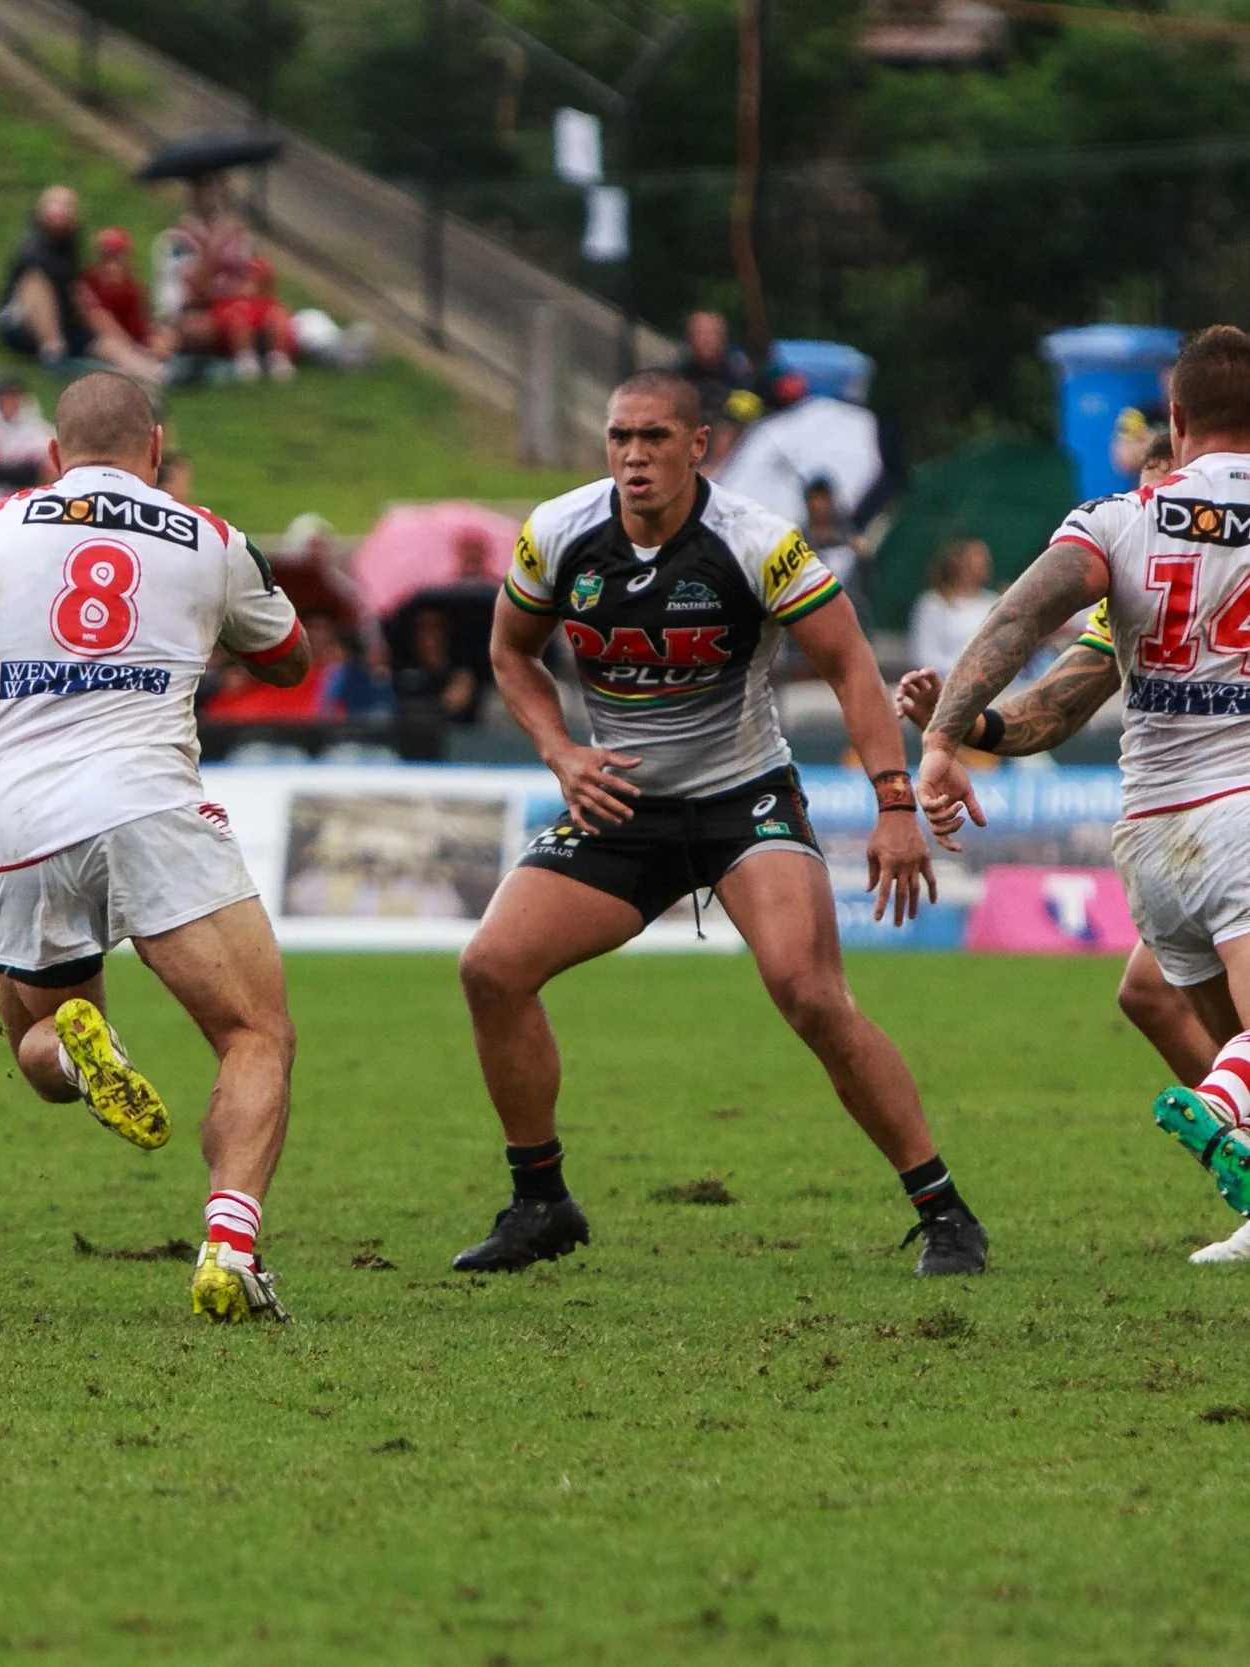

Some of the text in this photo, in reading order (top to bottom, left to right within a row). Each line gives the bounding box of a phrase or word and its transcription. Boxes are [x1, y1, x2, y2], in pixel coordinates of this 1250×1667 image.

[28, 496, 194, 542] DOMUS
[50, 538, 141, 658] 8
[563, 619, 731, 667] OAK
[602, 665, 724, 685] PLUS
